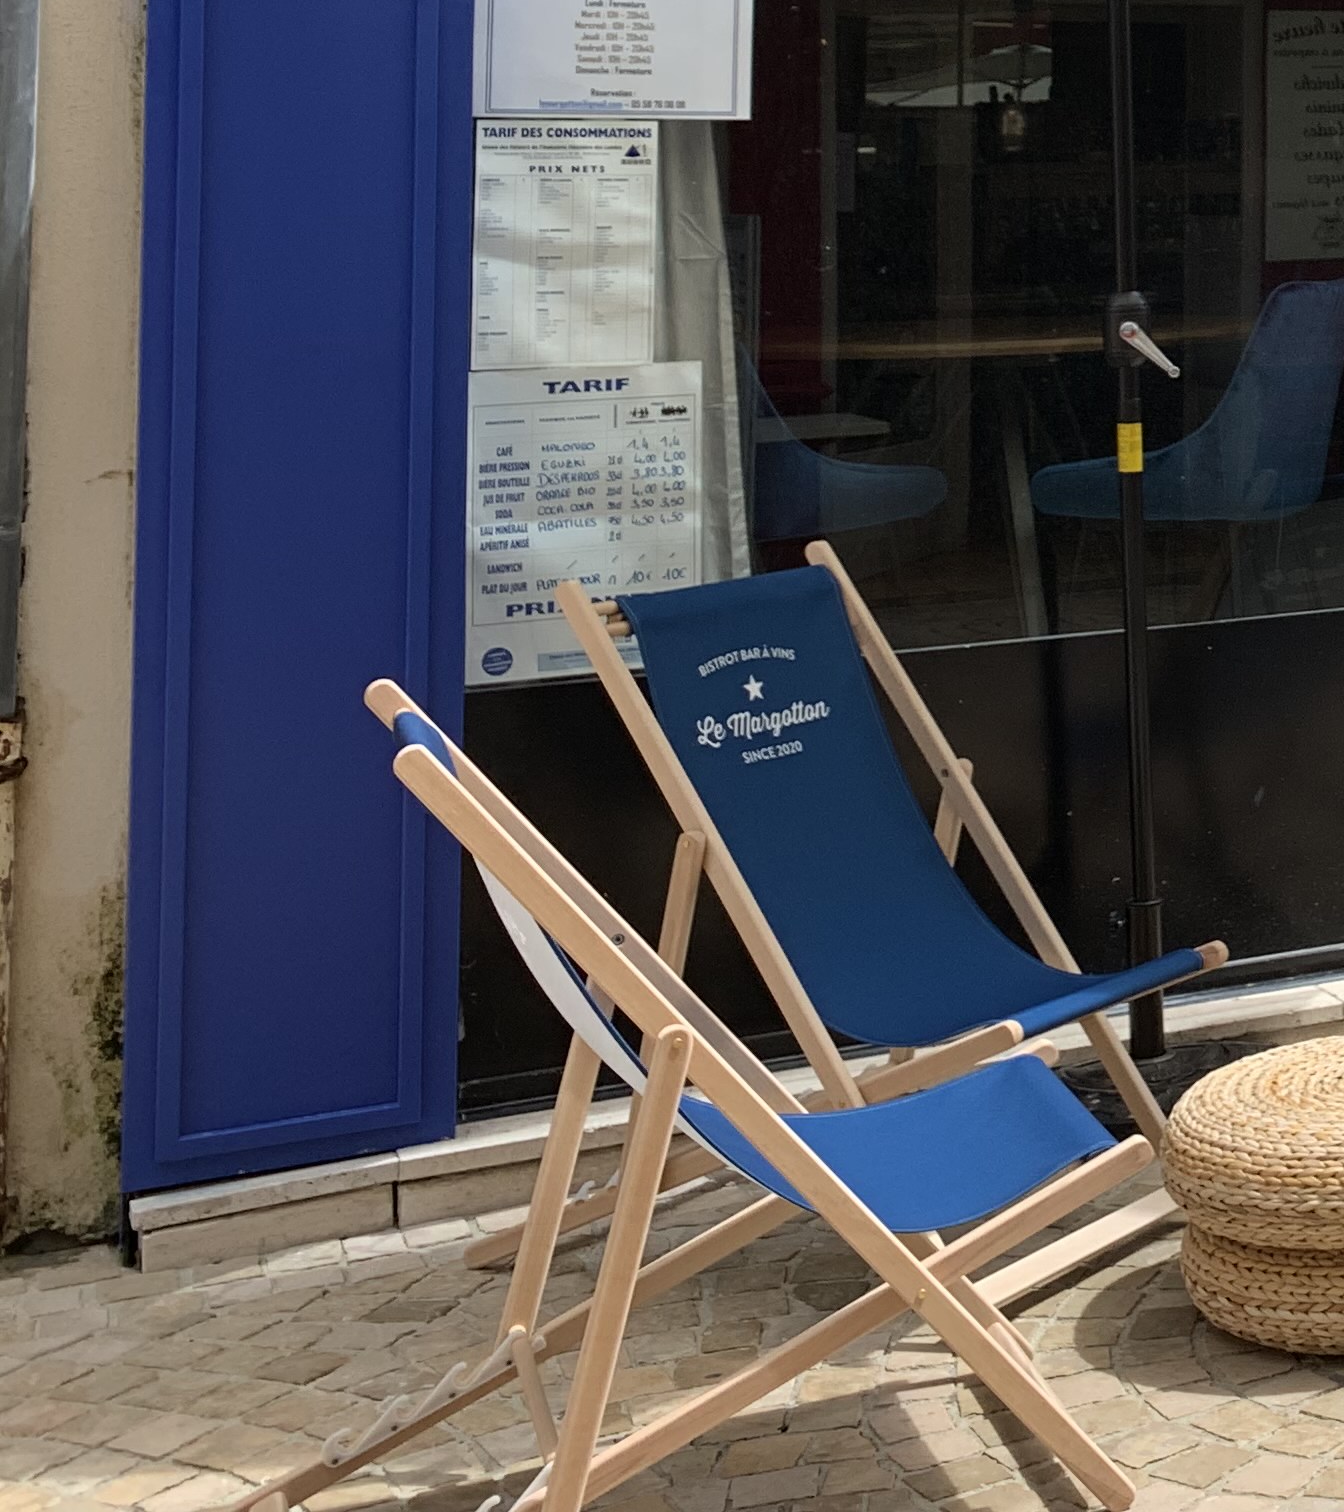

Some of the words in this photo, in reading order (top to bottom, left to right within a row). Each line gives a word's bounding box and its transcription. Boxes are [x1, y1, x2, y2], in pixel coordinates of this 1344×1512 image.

[482, 127, 518, 138] TARIF
[521, 127, 543, 138] DES
[546, 127, 653, 139] CONSOMMATIONS
[529, 164, 563, 174] PRIX
[571, 164, 606, 174] NETS
[542, 378, 630, 395] TARIF
[506, 601, 563, 618] PRI
[698, 651, 739, 677] BISTROT
[740, 646, 761, 661] BAR
[761, 644, 771, 659] À
[770, 647, 796, 661] VINS
[697, 715, 727, 748] Le
[726, 700, 831, 740] Margotton
[741, 746, 777, 764] SINCE
[777, 740, 803, 757] 2020
